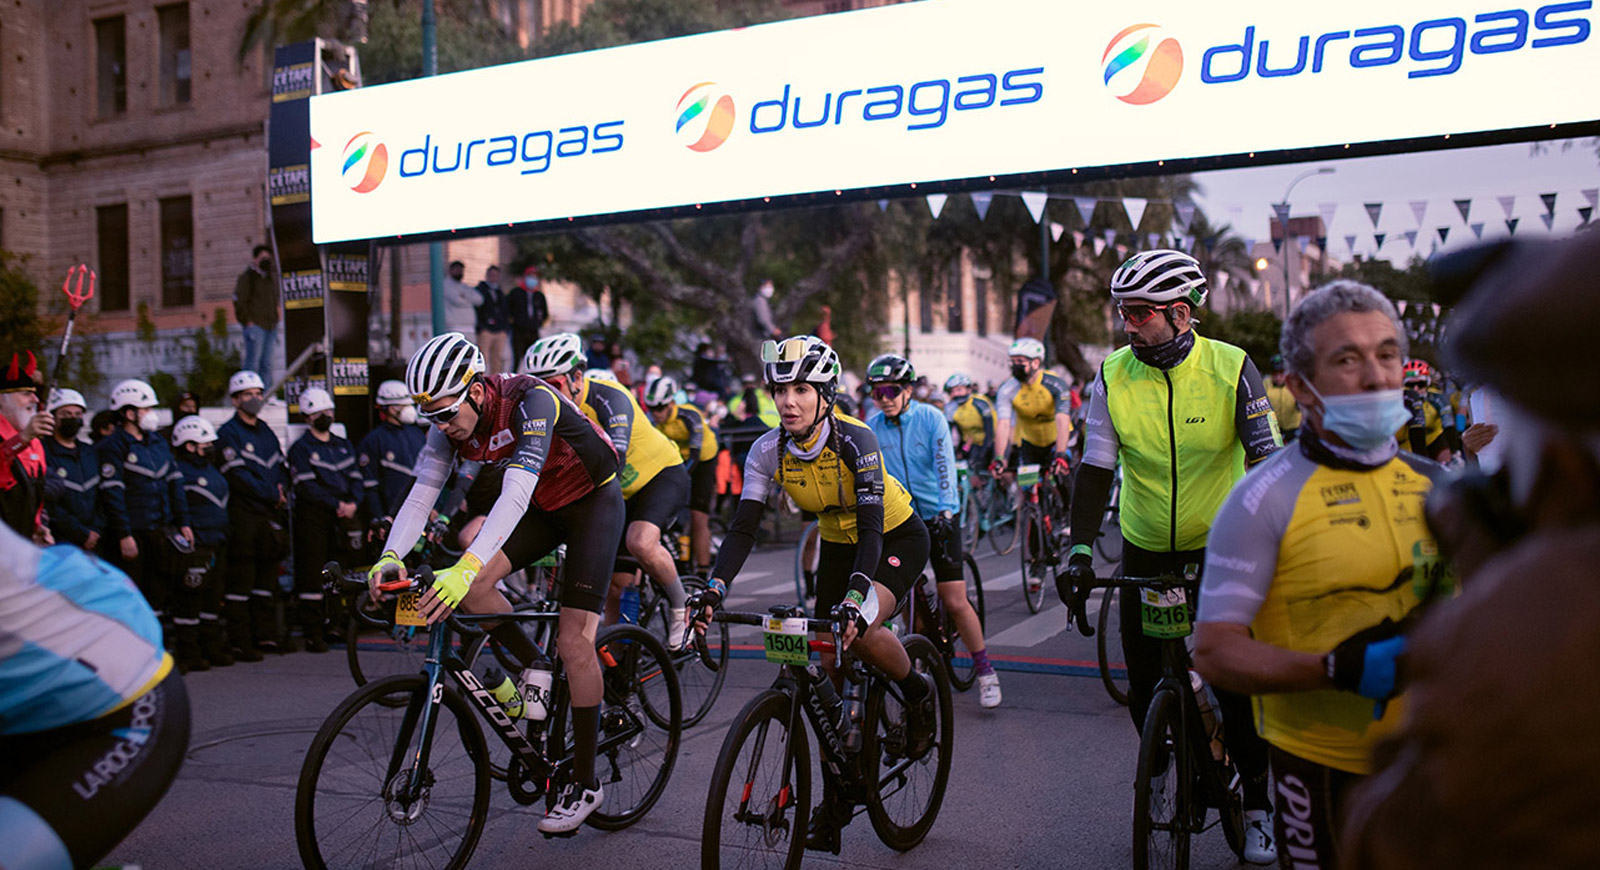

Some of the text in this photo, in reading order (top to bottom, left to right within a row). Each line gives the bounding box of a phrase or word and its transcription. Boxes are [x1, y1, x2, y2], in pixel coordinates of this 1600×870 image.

[1200, 0, 1593, 84] duragas
[750, 66, 1045, 133] duragas
[400, 119, 625, 177] duragas
[767, 635, 805, 653] 1504
[1145, 605, 1185, 625] 1216
[454, 669, 540, 757] SCOTT
